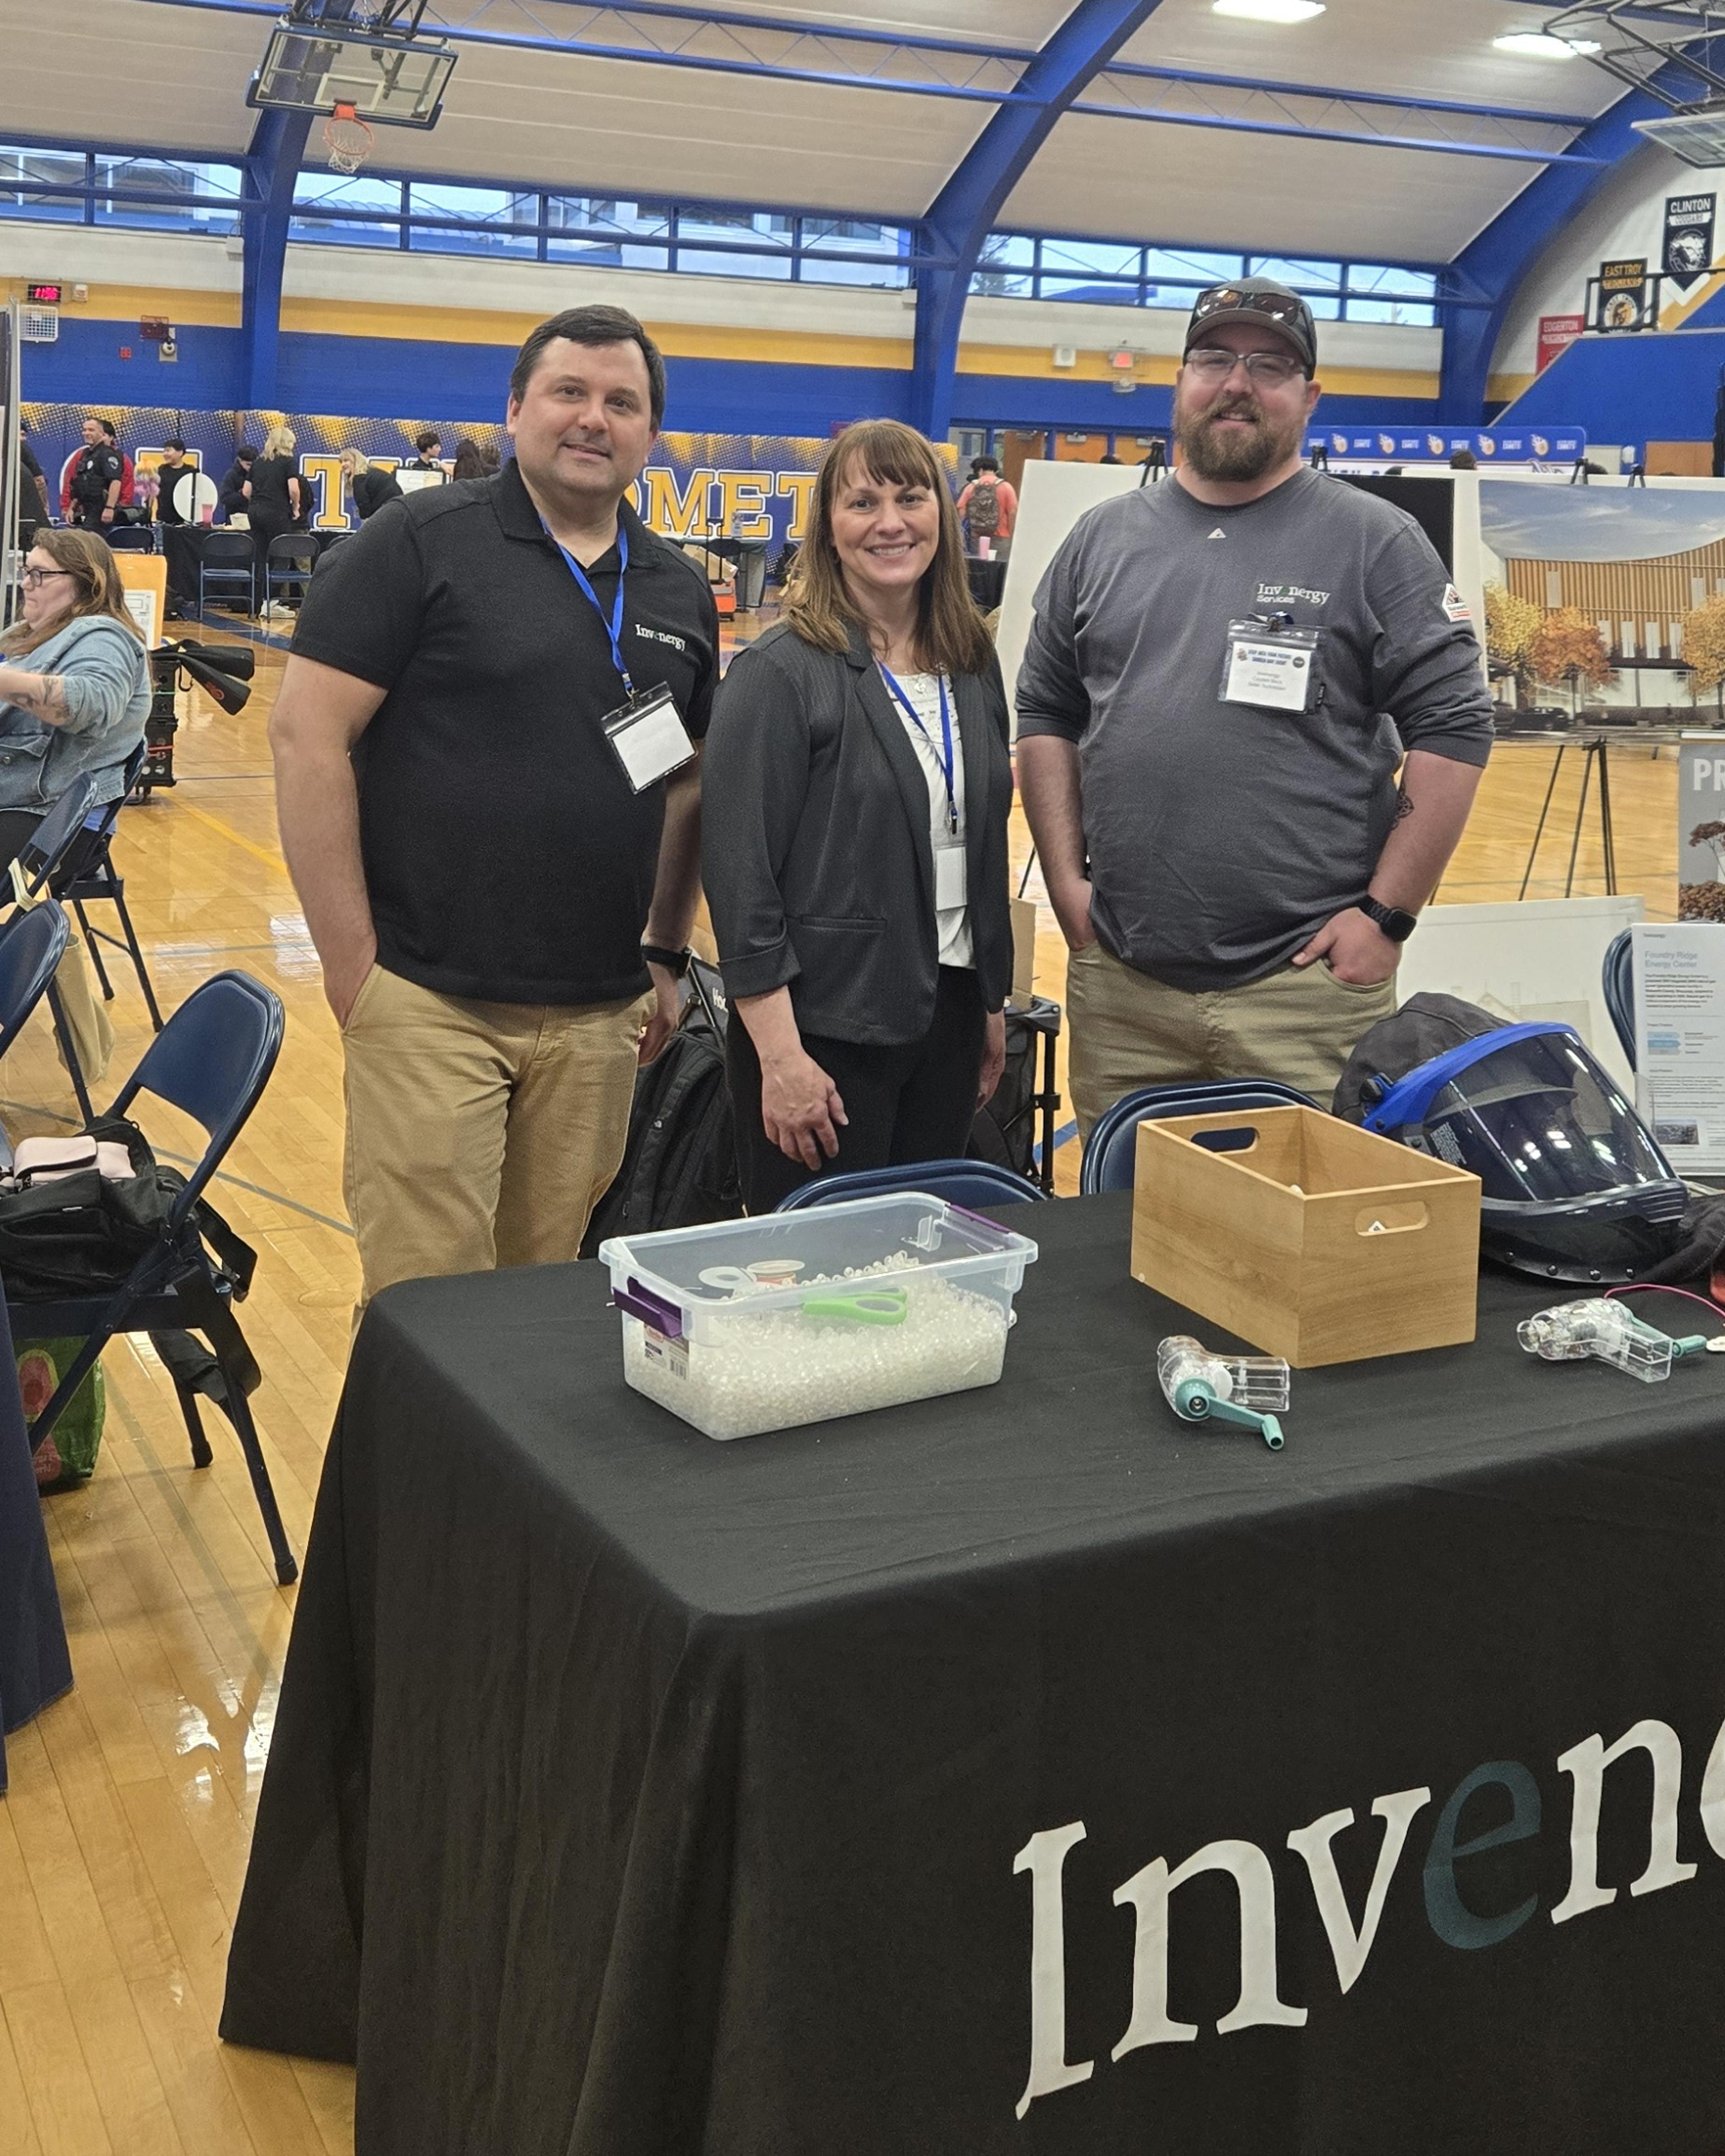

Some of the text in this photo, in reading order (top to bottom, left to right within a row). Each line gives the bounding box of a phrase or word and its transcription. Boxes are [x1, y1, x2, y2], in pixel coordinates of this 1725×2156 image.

[1671, 198, 1711, 213] CLINTON
[1605, 264, 1642, 277] EAST TROY
[635, 624, 686, 651] Invenergy
[1694, 758, 1725, 791] PR
[1645, 951, 1698, 960] Foundry Ridge
[1645, 960, 1671, 968] Energy
[1013, 1719, 1725, 2120] Inven
